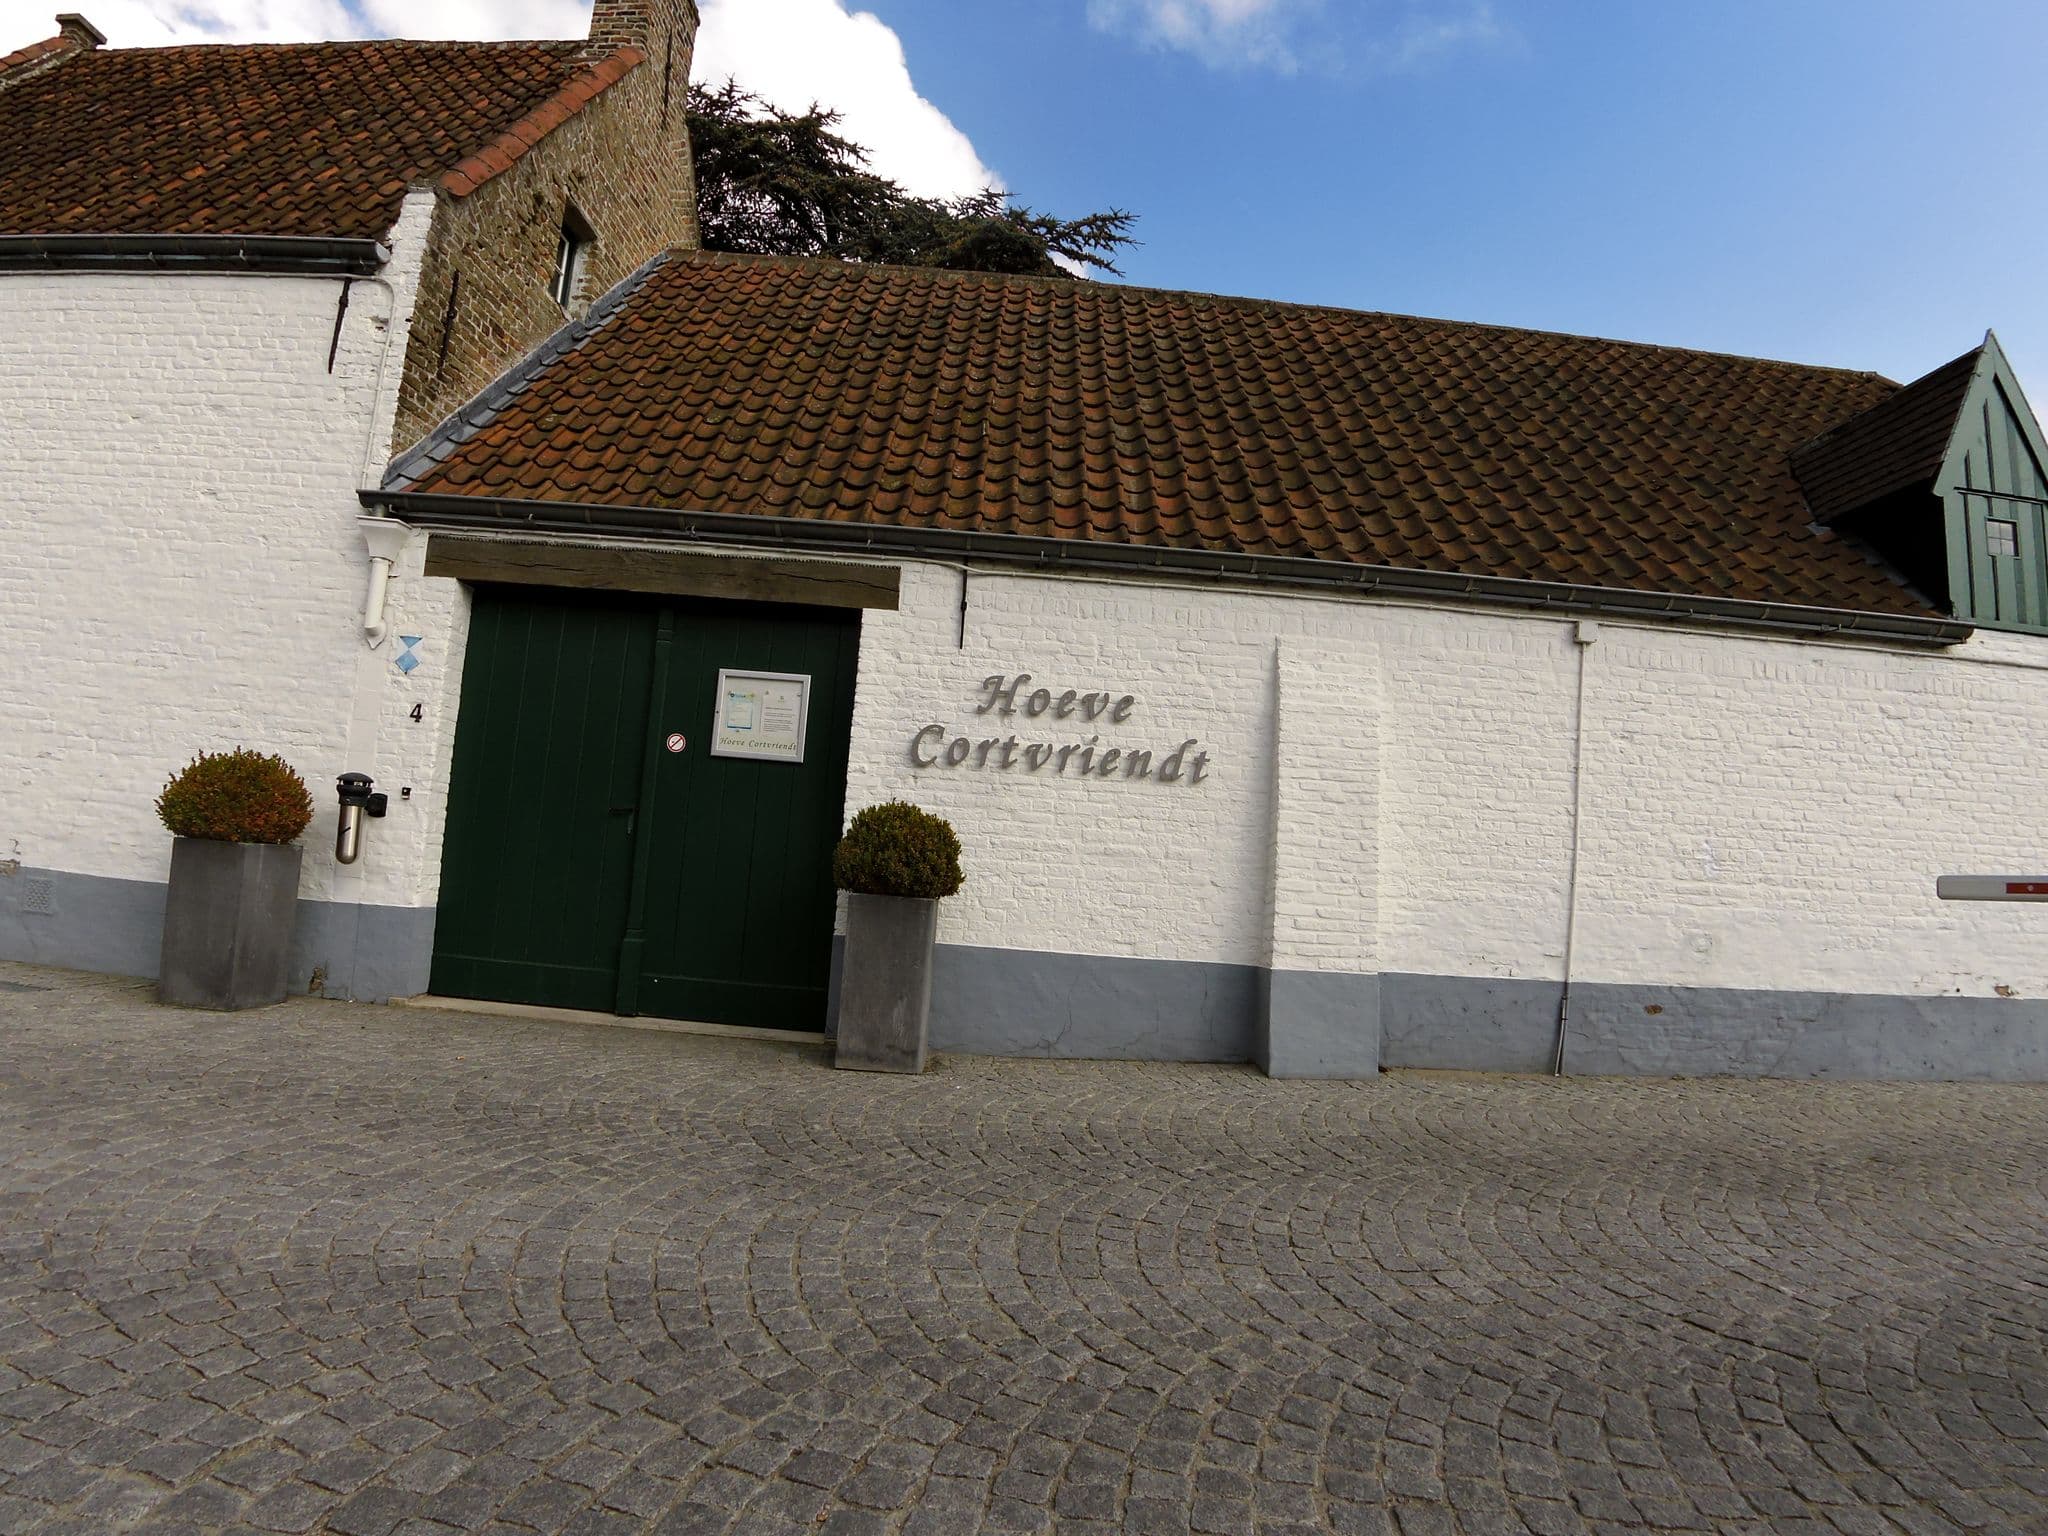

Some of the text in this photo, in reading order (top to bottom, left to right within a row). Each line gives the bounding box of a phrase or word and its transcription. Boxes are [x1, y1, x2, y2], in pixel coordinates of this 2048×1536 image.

[409, 703, 422, 723] 4
[976, 674, 1135, 722] Hoeve
[720, 737, 797, 751] Hoeve Cortvriendt
[911, 724, 1210, 783] Cortvriendt
